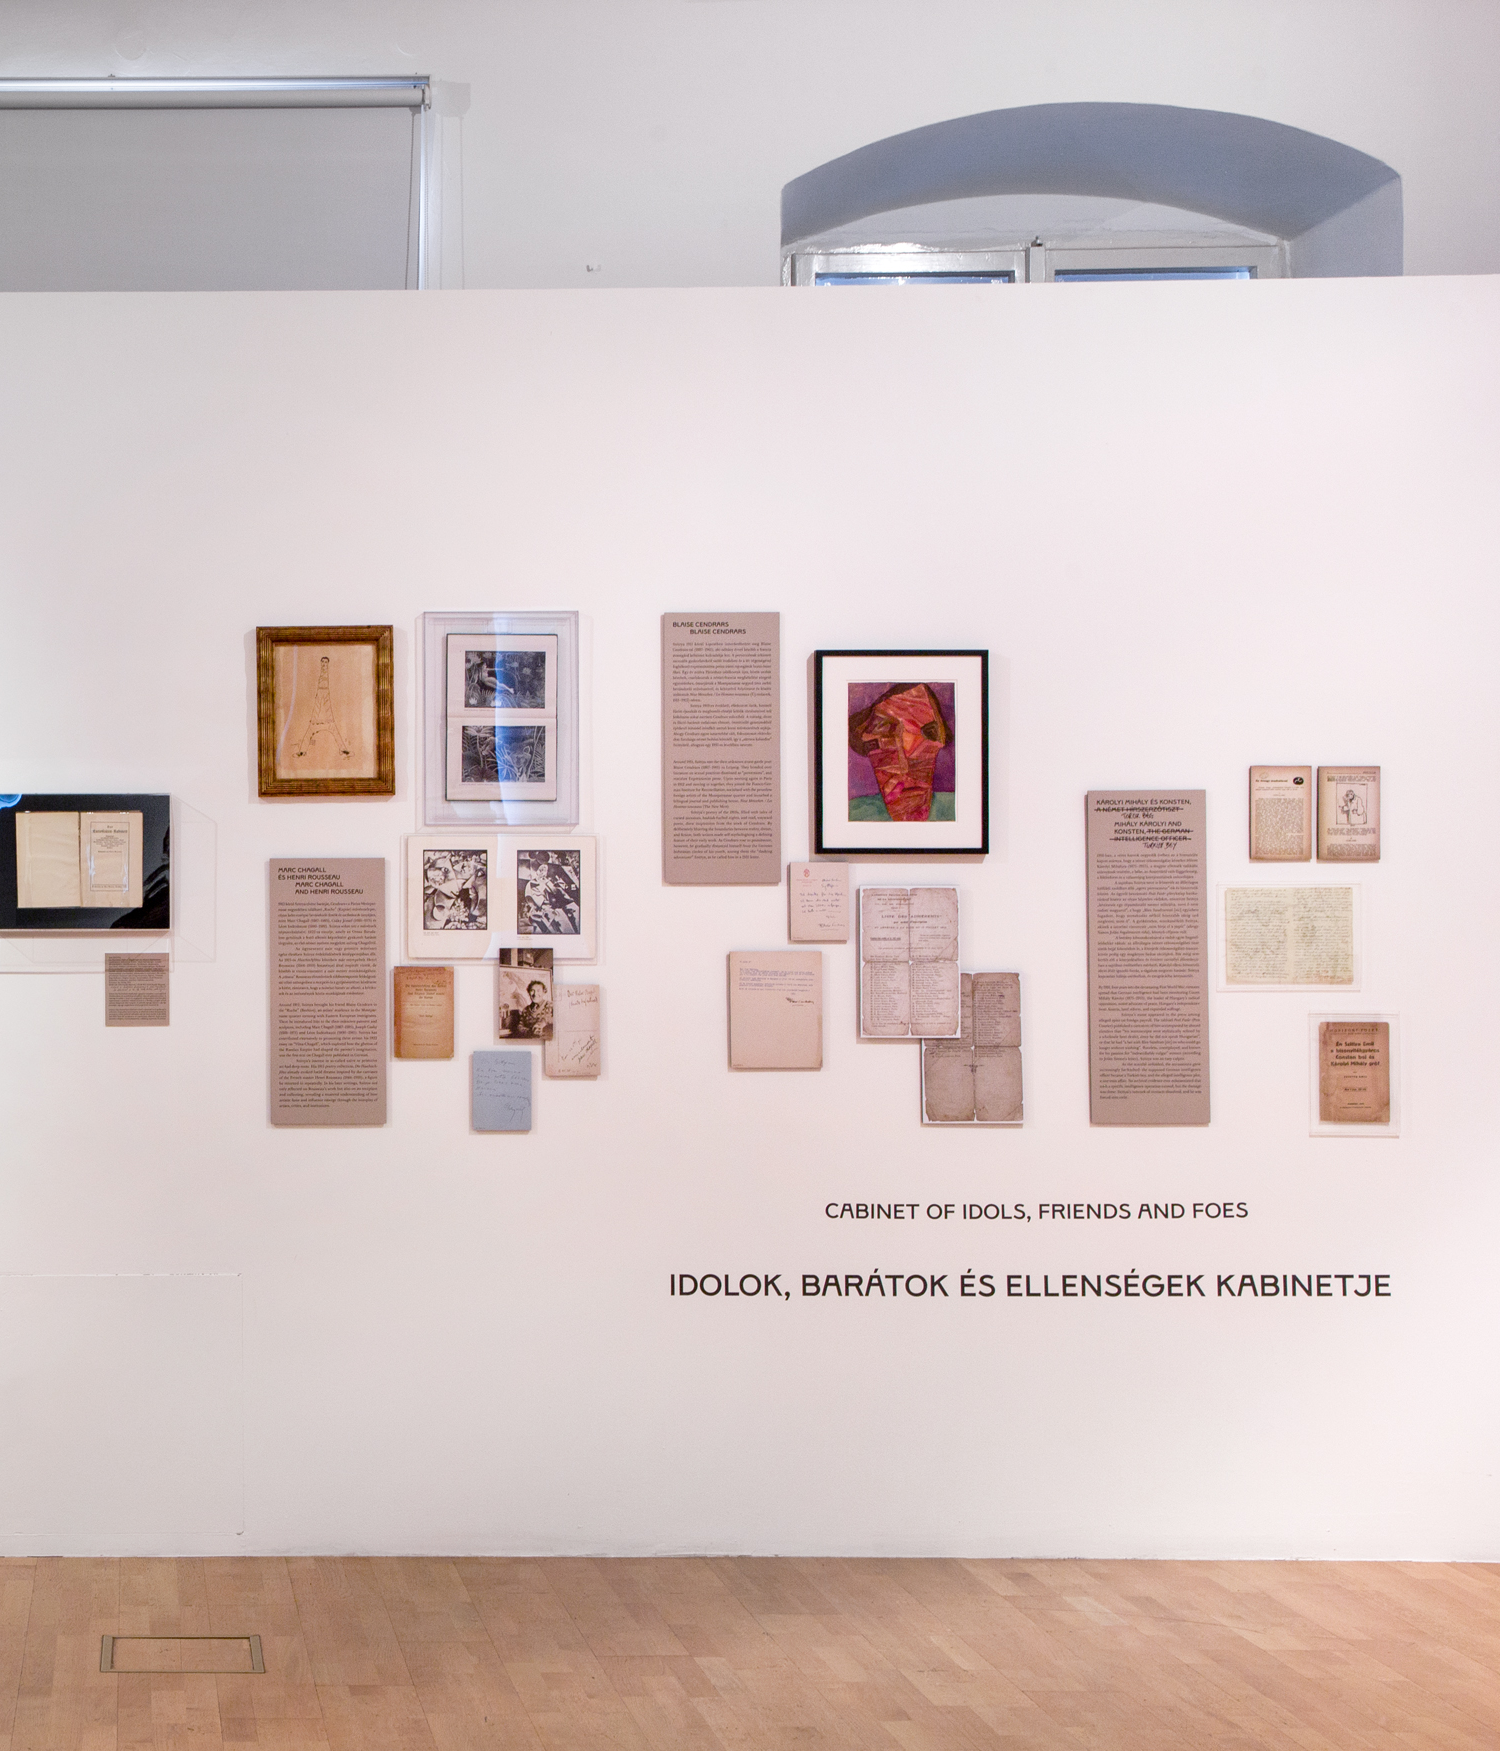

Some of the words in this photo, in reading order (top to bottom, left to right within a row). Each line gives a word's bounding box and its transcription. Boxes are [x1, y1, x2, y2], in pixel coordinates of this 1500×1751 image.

[824, 1202, 921, 1220] CABINET
[925, 1203, 956, 1221] OF
[962, 1203, 1032, 1224] IDOLS,
[1038, 1202, 1132, 1220] FRIENDS
[1137, 1202, 1186, 1220] AND
[1192, 1201, 1249, 1220] FOES
[670, 1273, 791, 1302] IDOLOK,
[801, 1267, 950, 1298] BARÁTOK
[959, 1267, 996, 1298] ÉS
[1006, 1267, 1206, 1298] ELLENSÉGEK
[1216, 1273, 1392, 1298] KABINETJE
